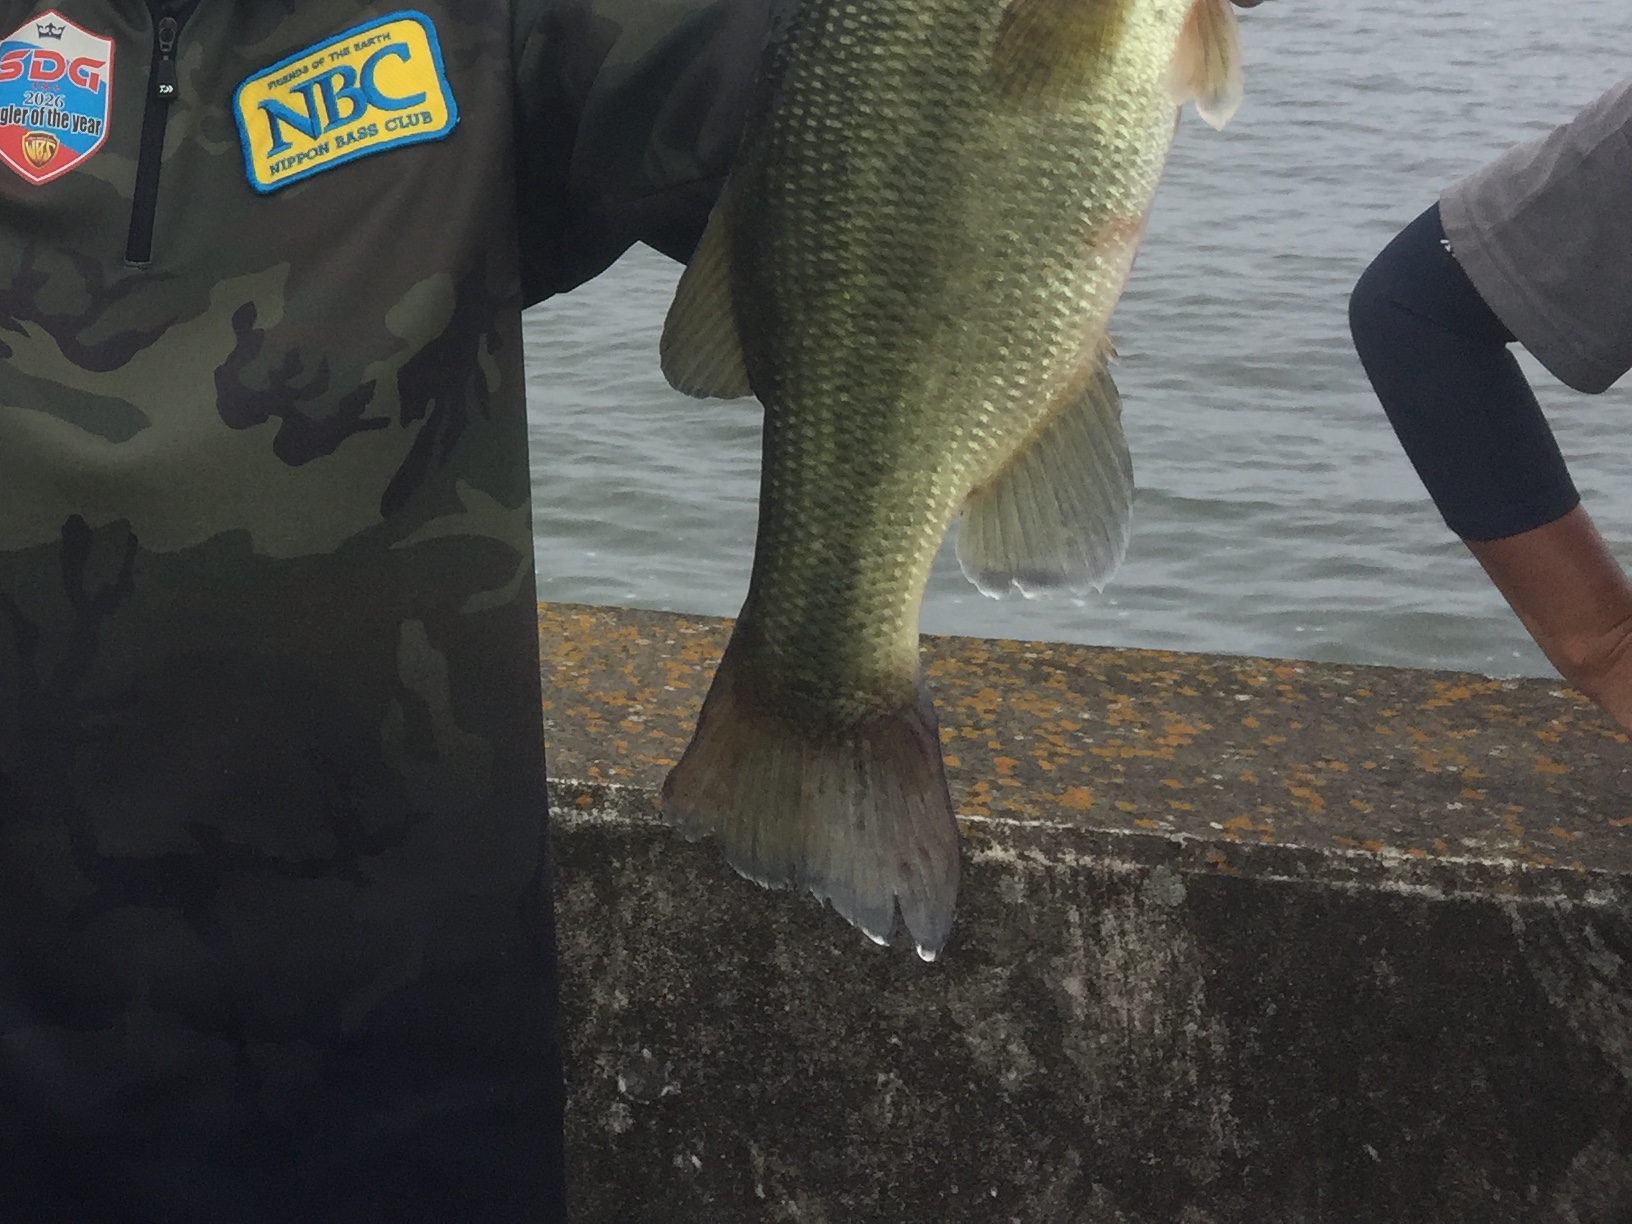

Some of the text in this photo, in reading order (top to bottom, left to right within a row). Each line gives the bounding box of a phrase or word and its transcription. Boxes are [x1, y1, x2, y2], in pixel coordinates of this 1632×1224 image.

[268, 32, 391, 90] FRIENDS OF THE EARTH
[23, 91, 65, 109] 2026
[31, 107, 45, 125] of
[48, 109, 69, 128] the
[73, 115, 101, 136] year
[257, 42, 426, 159] NBC
[25, 139, 56, 161] WBS
[270, 111, 433, 176] NIPPON BASS CLUB
